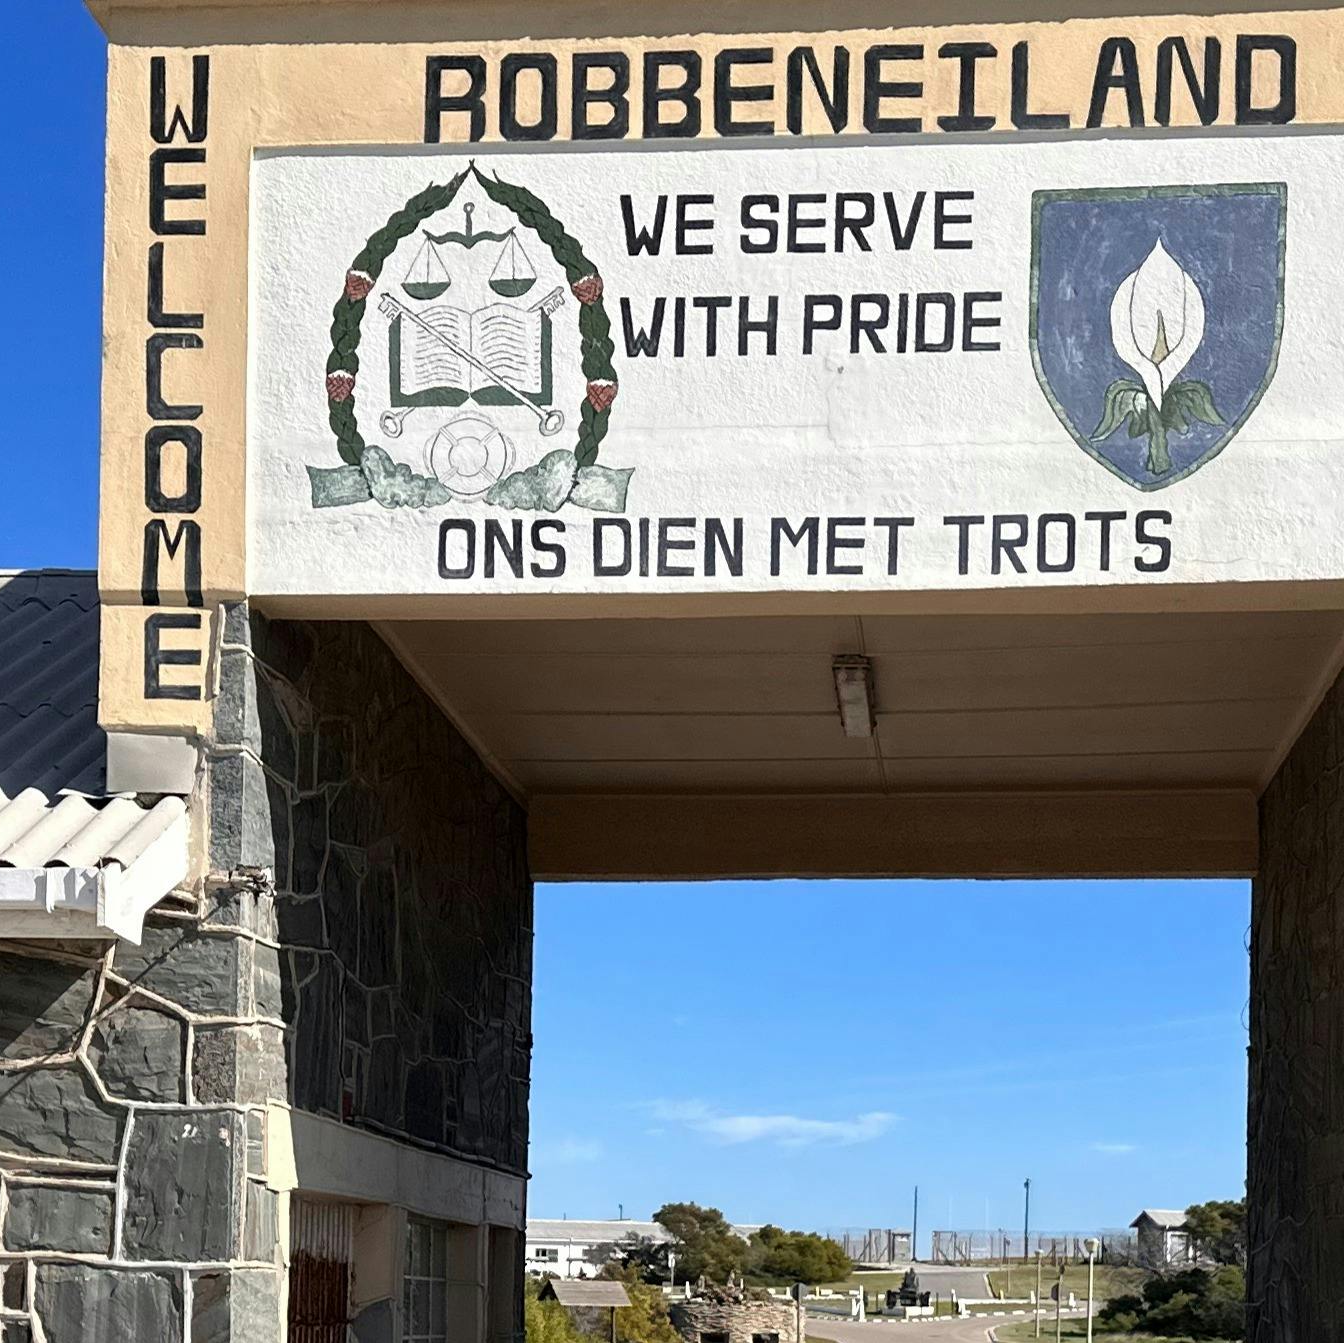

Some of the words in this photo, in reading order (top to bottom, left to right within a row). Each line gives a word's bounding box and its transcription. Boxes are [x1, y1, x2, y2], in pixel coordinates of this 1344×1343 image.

[424, 35, 1297, 143] ROBBENEILAND
[620, 194, 715, 257] WE
[741, 191, 975, 254] SERVE
[620, 295, 779, 358] WITH
[803, 292, 1002, 355] PRIDE
[142, 55, 210, 700] WELCOME
[438, 518, 567, 580] ONS
[593, 517, 743, 577] DIEN
[771, 516, 914, 577] MET
[944, 511, 1173, 575] TROTS
